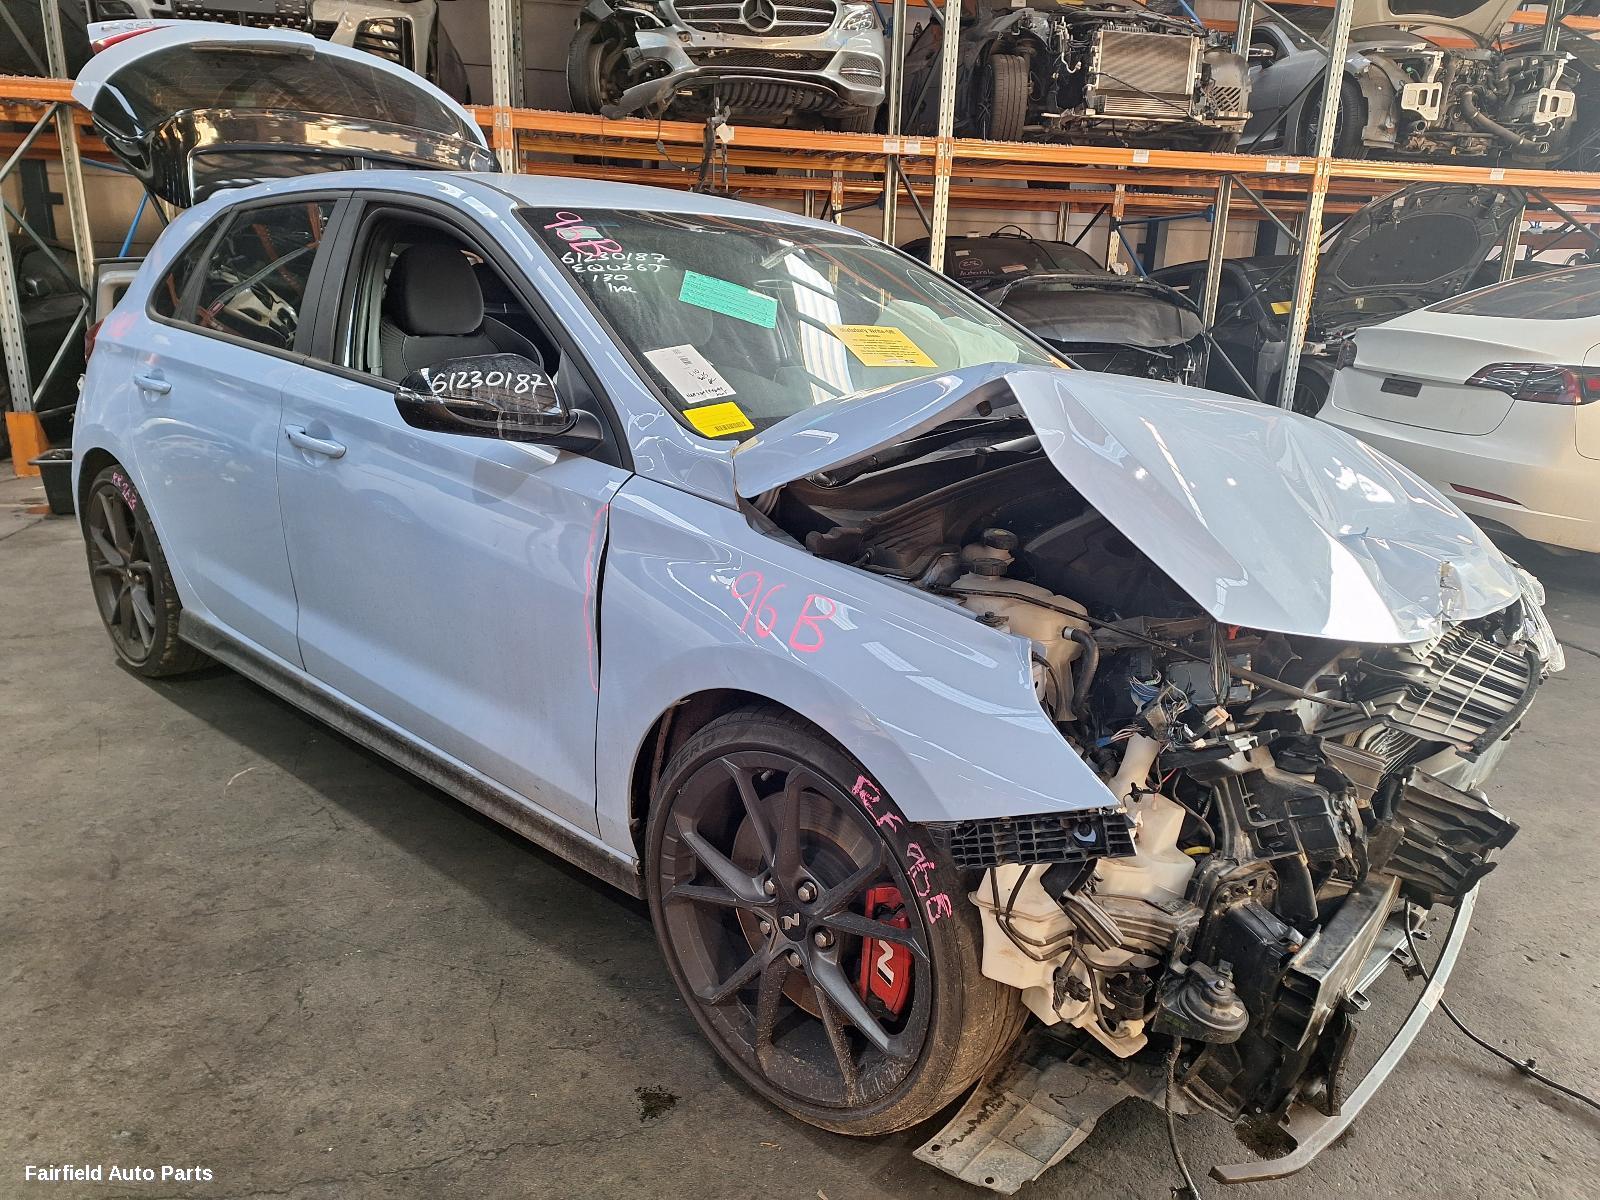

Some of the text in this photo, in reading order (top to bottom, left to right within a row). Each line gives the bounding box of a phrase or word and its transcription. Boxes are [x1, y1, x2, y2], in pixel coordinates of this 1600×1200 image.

[561, 251, 671, 264] 61230187
[430, 370, 548, 395] 61230187
[731, 569, 837, 653] 96 B
